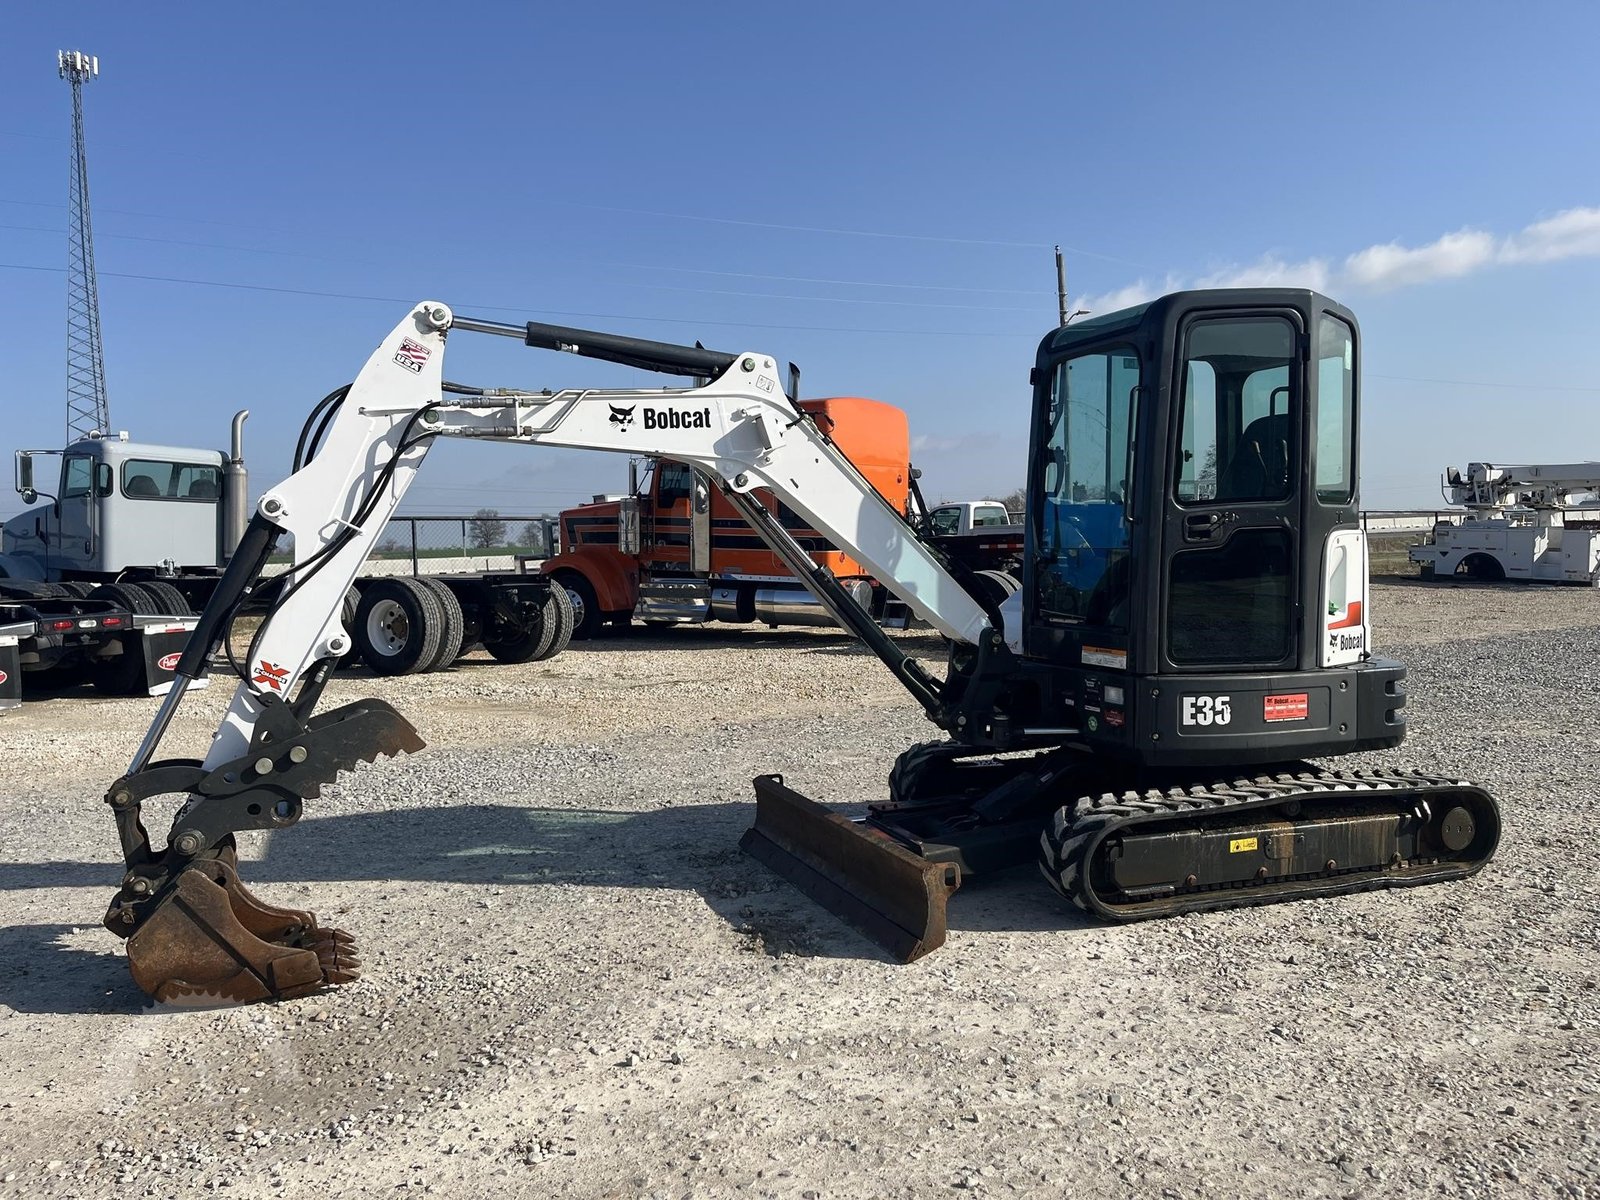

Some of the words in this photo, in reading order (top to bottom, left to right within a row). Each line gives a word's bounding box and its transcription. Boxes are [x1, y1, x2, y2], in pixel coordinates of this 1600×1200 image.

[395, 353, 420, 371] USA
[643, 407, 711, 430] Bobcat
[1340, 633, 1362, 651] Bobcat
[1183, 696, 1231, 726] E35
